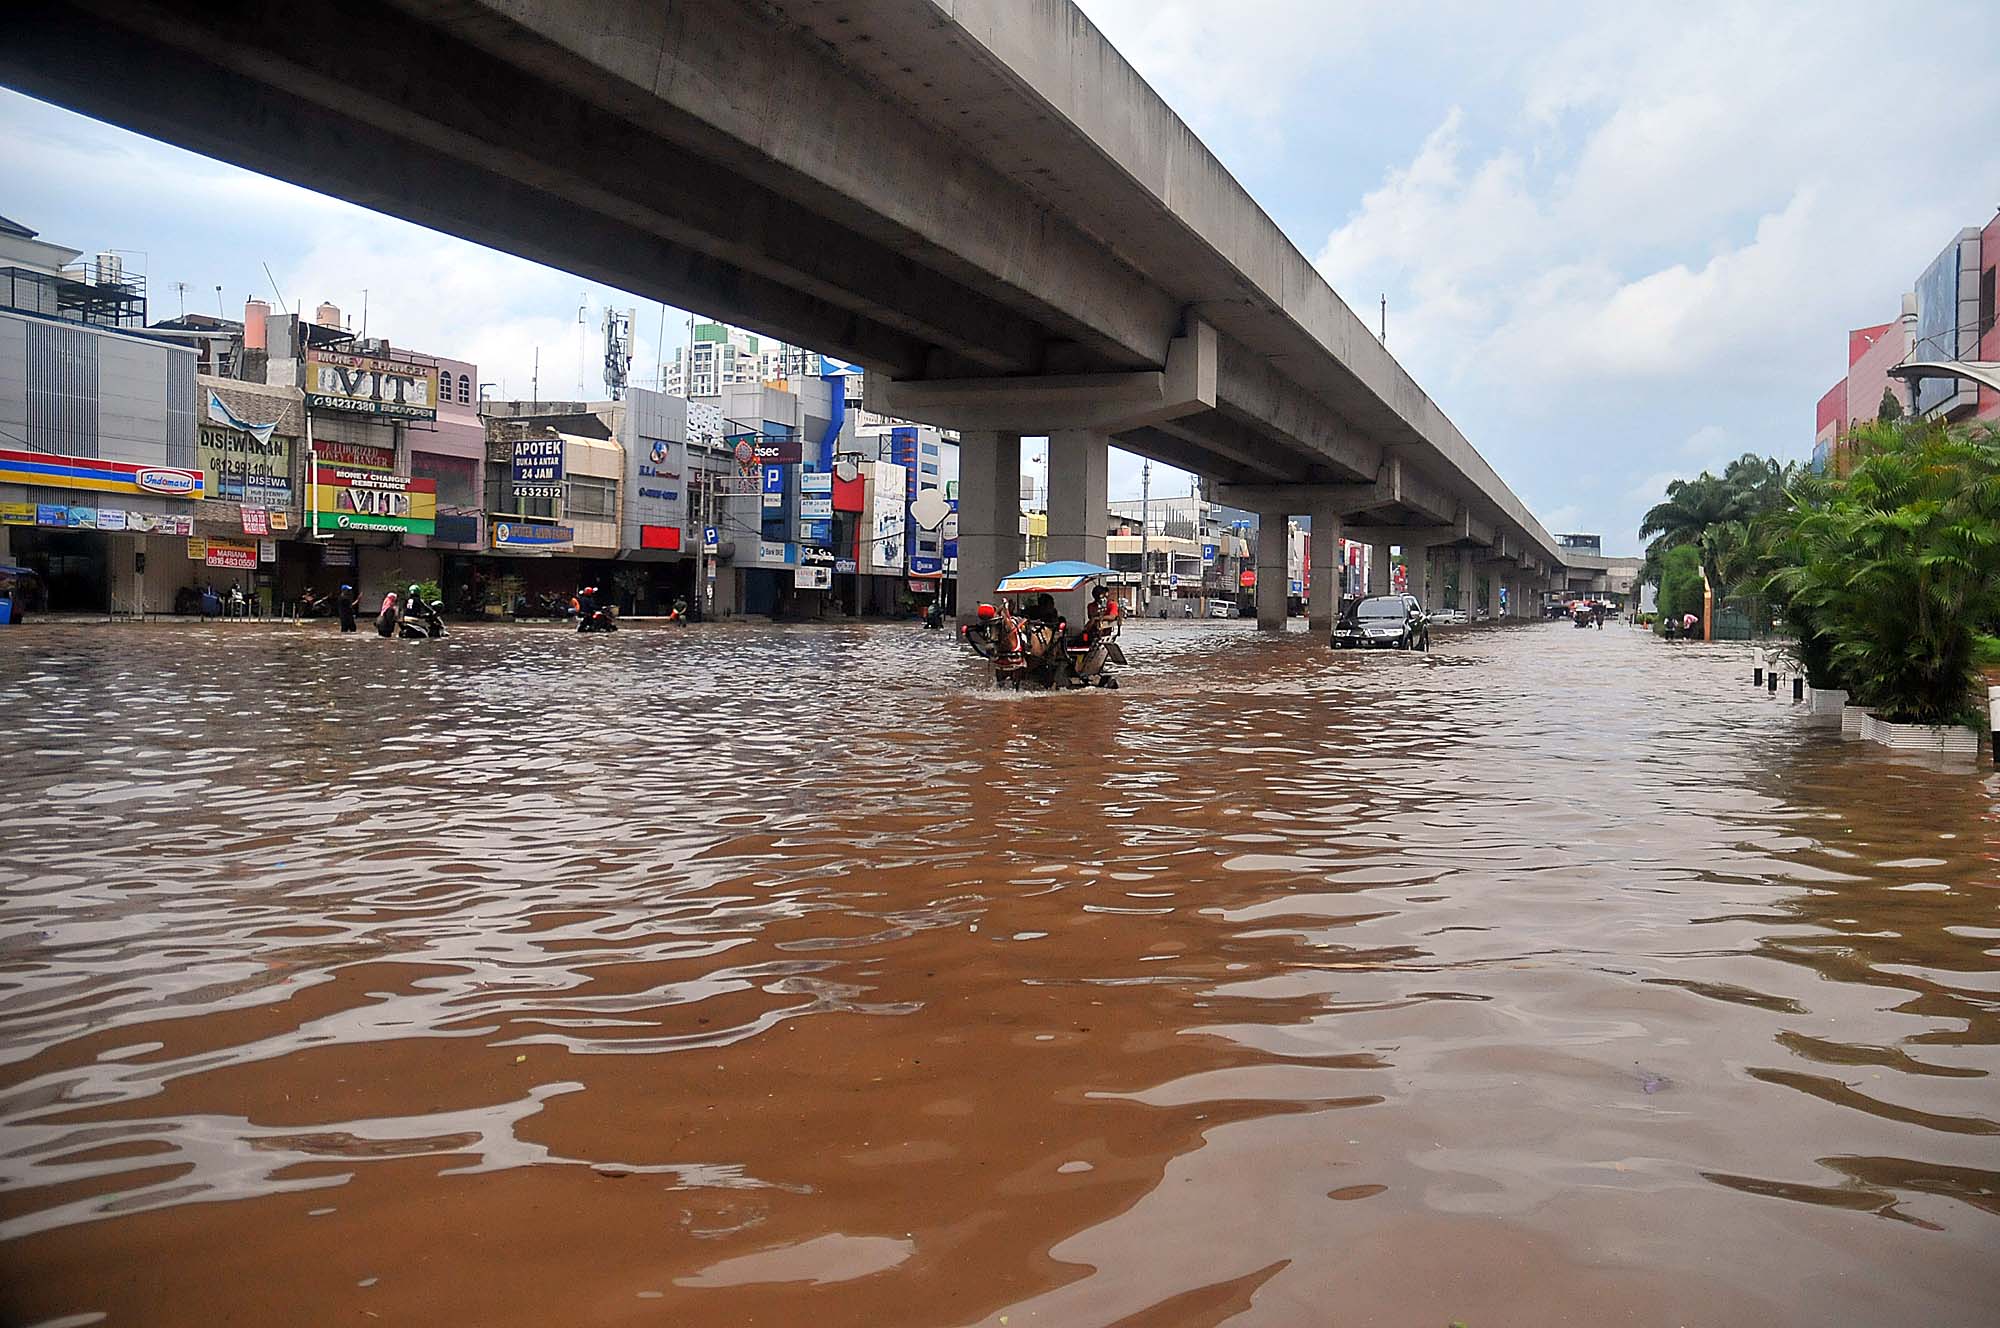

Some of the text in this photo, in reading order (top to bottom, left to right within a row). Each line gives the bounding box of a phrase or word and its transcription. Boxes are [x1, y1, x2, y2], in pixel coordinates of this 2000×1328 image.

[317, 351, 428, 378] MONEY CHANGER
[334, 365, 415, 404] VIT
[325, 396, 376, 412] 94237380
[514, 441, 561, 456] APOTEK
[538, 457, 559, 466] ANTAR
[336, 471, 411, 484] MONEY CHANGER
[521, 468, 553, 479] 24 JAM
[767, 469, 779, 489] P
[144, 474, 191, 488] Indomaret
[248, 475, 287, 487] DISEWA
[513, 487, 561, 497] 4532512
[345, 488, 402, 516] VIT
[706, 528, 716, 543] P
[216, 549, 247, 558] MARIANA
[1204, 547, 1212, 558] P
